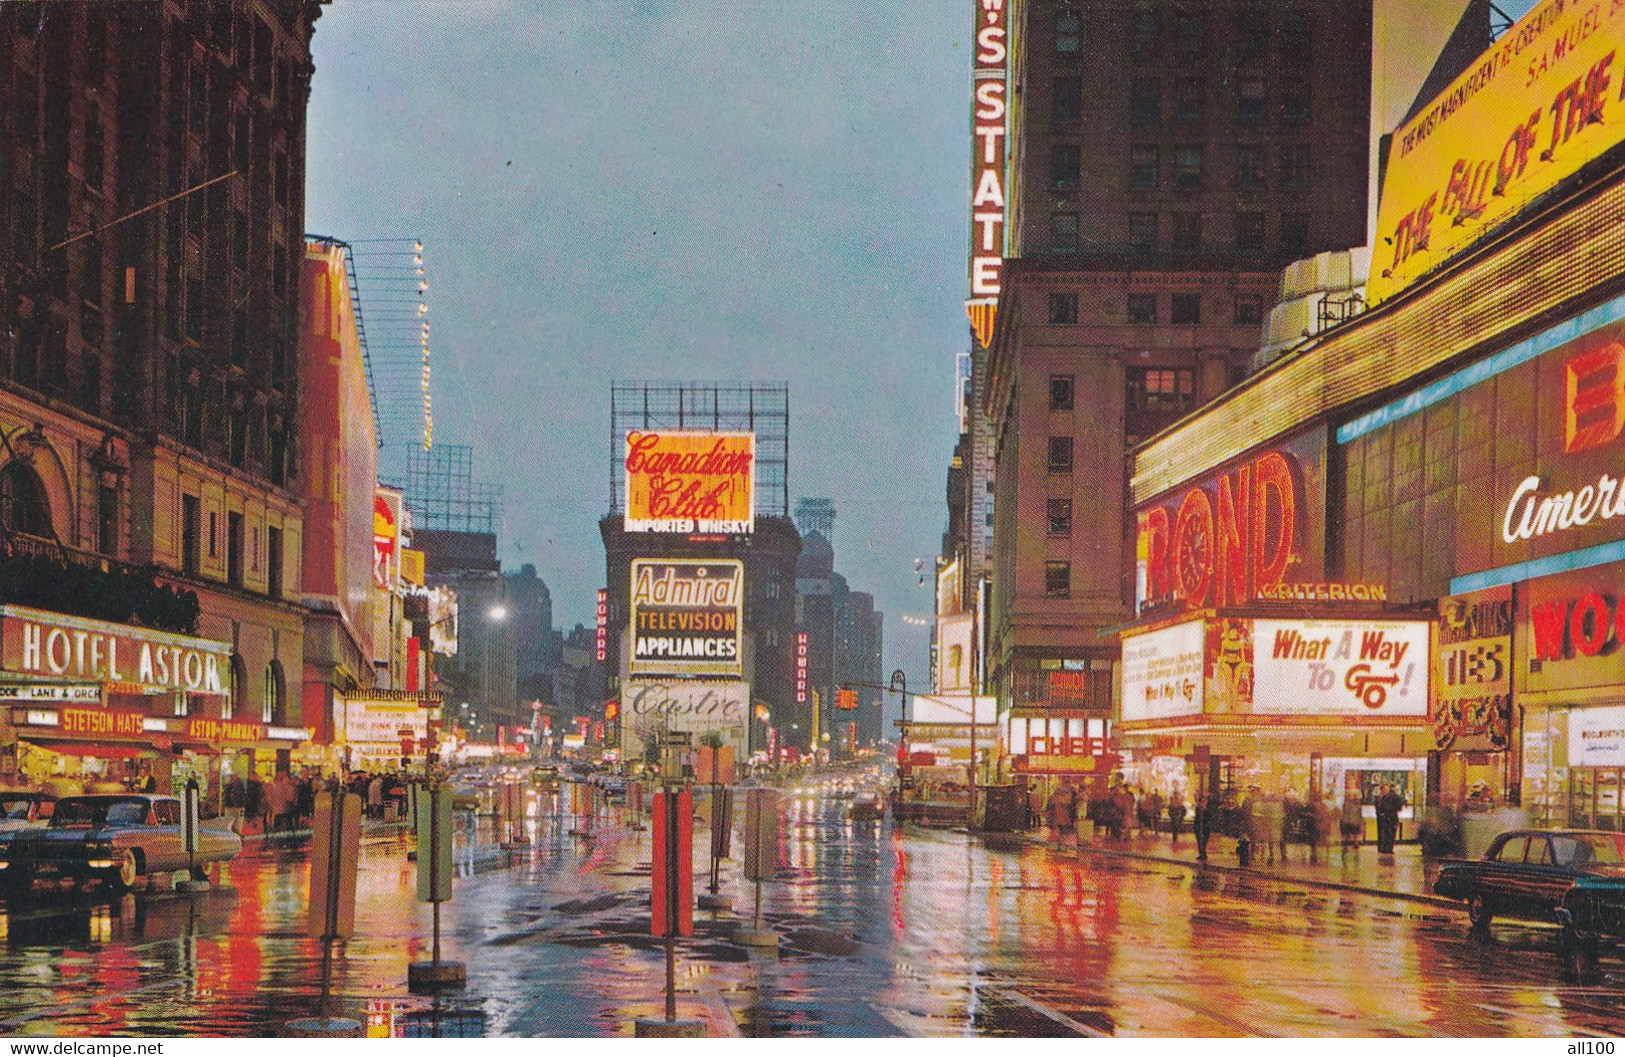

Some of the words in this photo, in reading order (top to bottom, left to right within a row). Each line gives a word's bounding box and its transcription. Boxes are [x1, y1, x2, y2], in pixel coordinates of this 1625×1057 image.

[1526, 5, 1600, 88] SAMUEL
[1401, 127, 1416, 158] THE
[1416, 106, 1439, 147] MOST
[1391, 189, 1438, 271] THE
[1439, 158, 1496, 221] FALL
[1493, 106, 1543, 194] OF
[1548, 49, 1616, 158] THE
[972, 82, 1007, 294] STATE
[625, 431, 753, 475] Canadian
[648, 475, 731, 519] Club
[631, 520, 694, 534] IMPORTED
[697, 520, 750, 534] WHISKY
[1145, 451, 1295, 609] BOND
[633, 566, 740, 609] Admiral
[1260, 583, 1387, 601] CRITERION
[637, 611, 737, 631] TELEVISION
[1531, 592, 1625, 662] WO
[22, 622, 123, 681] HOTEL
[138, 642, 223, 695] ASTOR
[636, 637, 737, 657] APPLIANCES
[797, 633, 808, 702] HOWARD
[1272, 629, 1332, 661] What
[1333, 630, 1354, 661] A
[1359, 630, 1410, 670] Way
[1441, 644, 1504, 687] TIES
[31, 687, 56, 698] LANE
[62, 687, 69, 698] &
[74, 687, 101, 699] ORCH
[1308, 661, 1336, 692] To
[63, 708, 114, 732] STETSON
[117, 712, 144, 734] HATS
[624, 683, 742, 717] Castro
